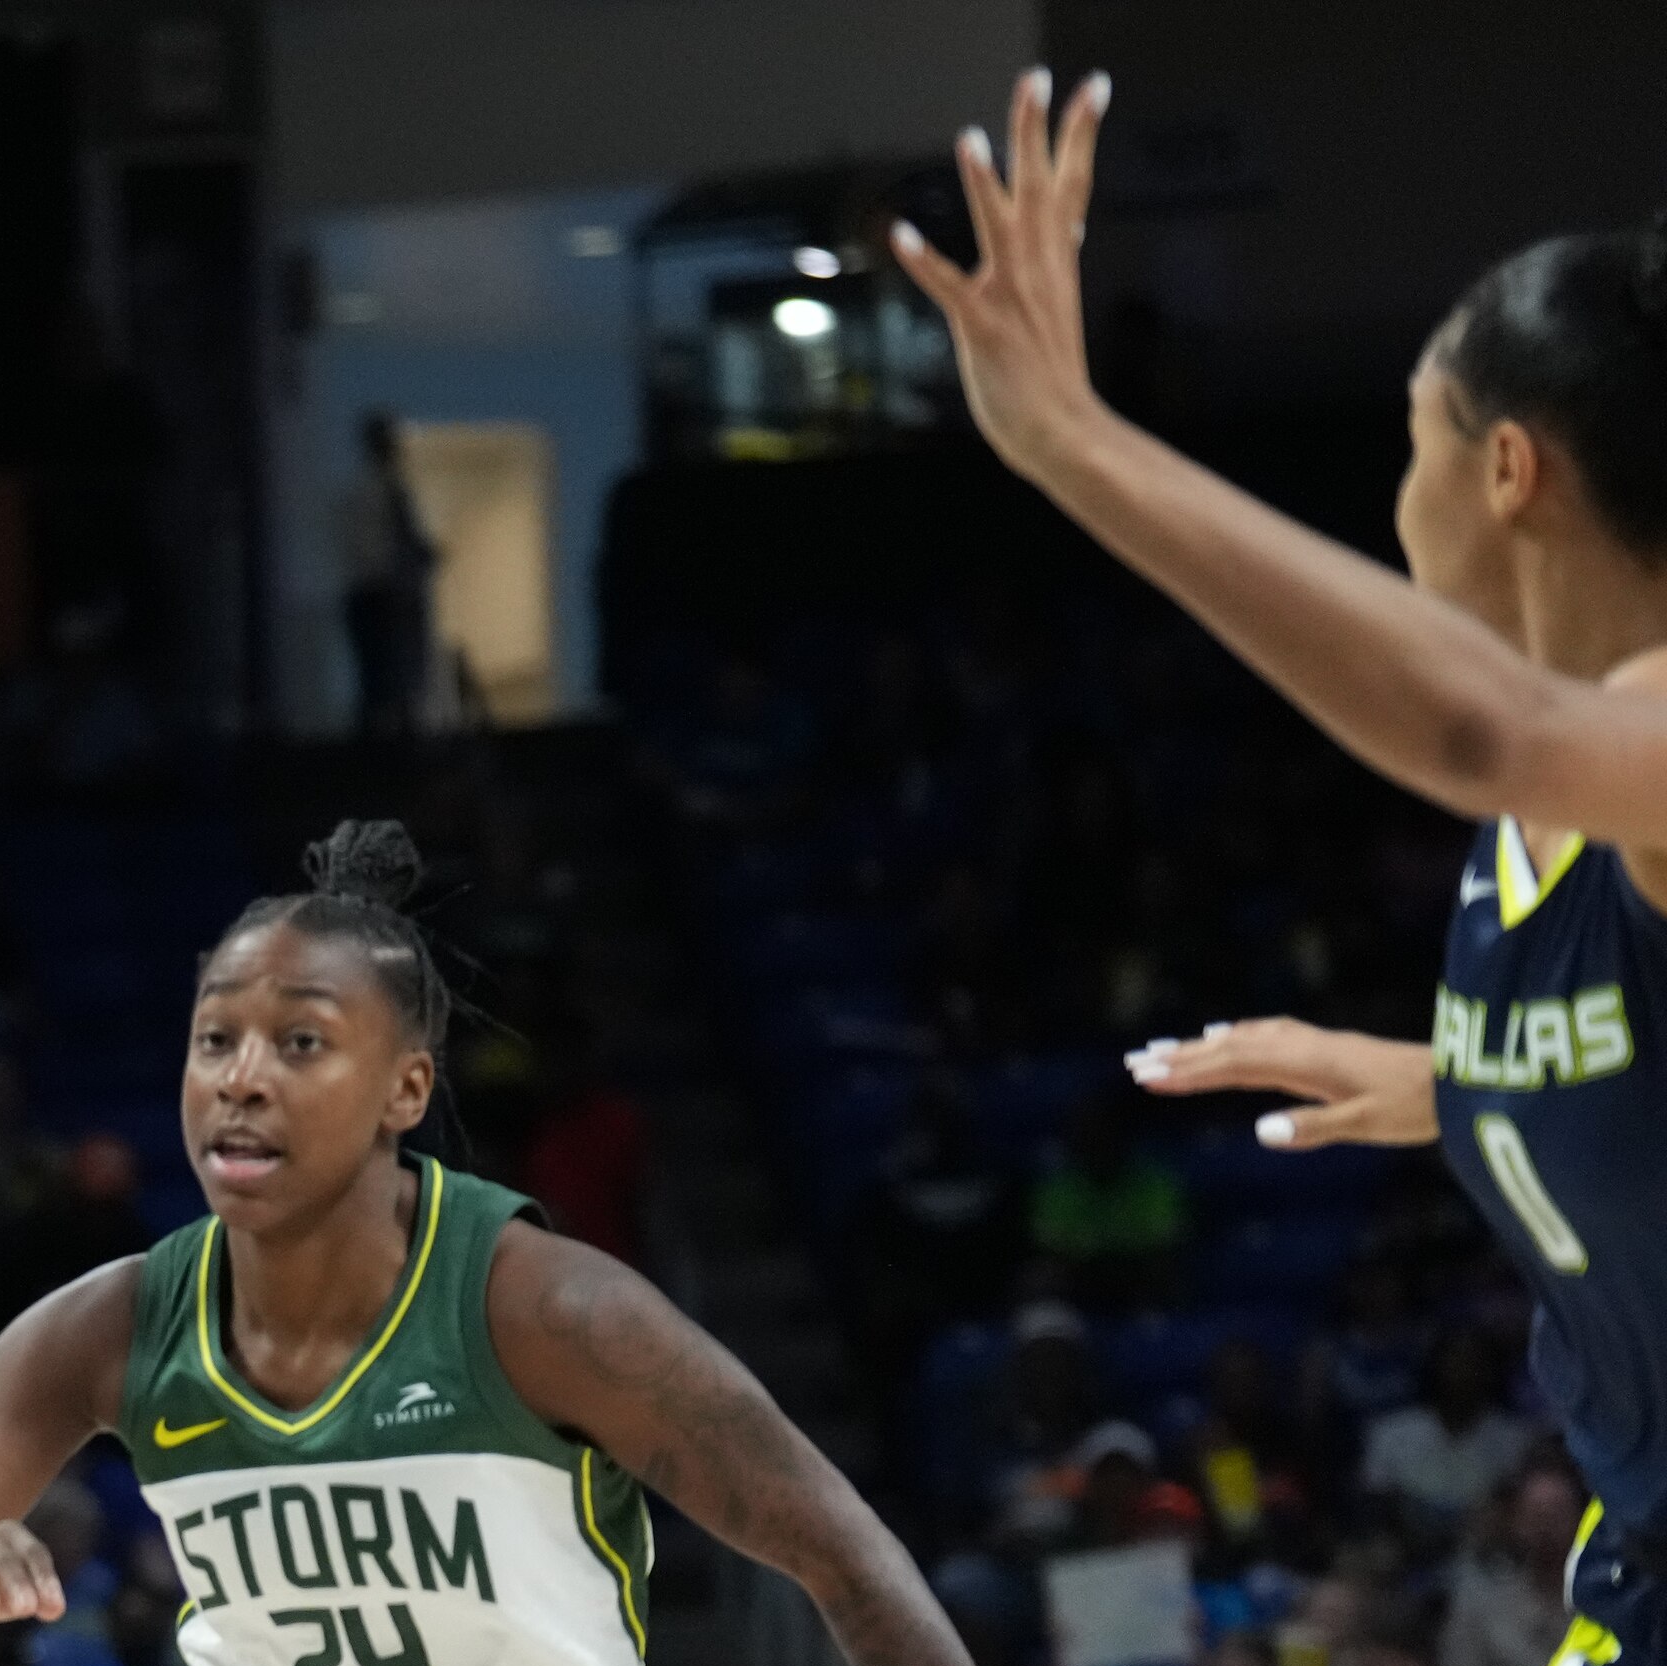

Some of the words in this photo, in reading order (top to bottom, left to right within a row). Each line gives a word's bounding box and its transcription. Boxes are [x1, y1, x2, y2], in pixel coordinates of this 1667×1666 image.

[1433, 980, 1634, 1092] ALLAS
[373, 1401, 456, 1431] SYMETRA
[175, 1483, 497, 1611] STORM
